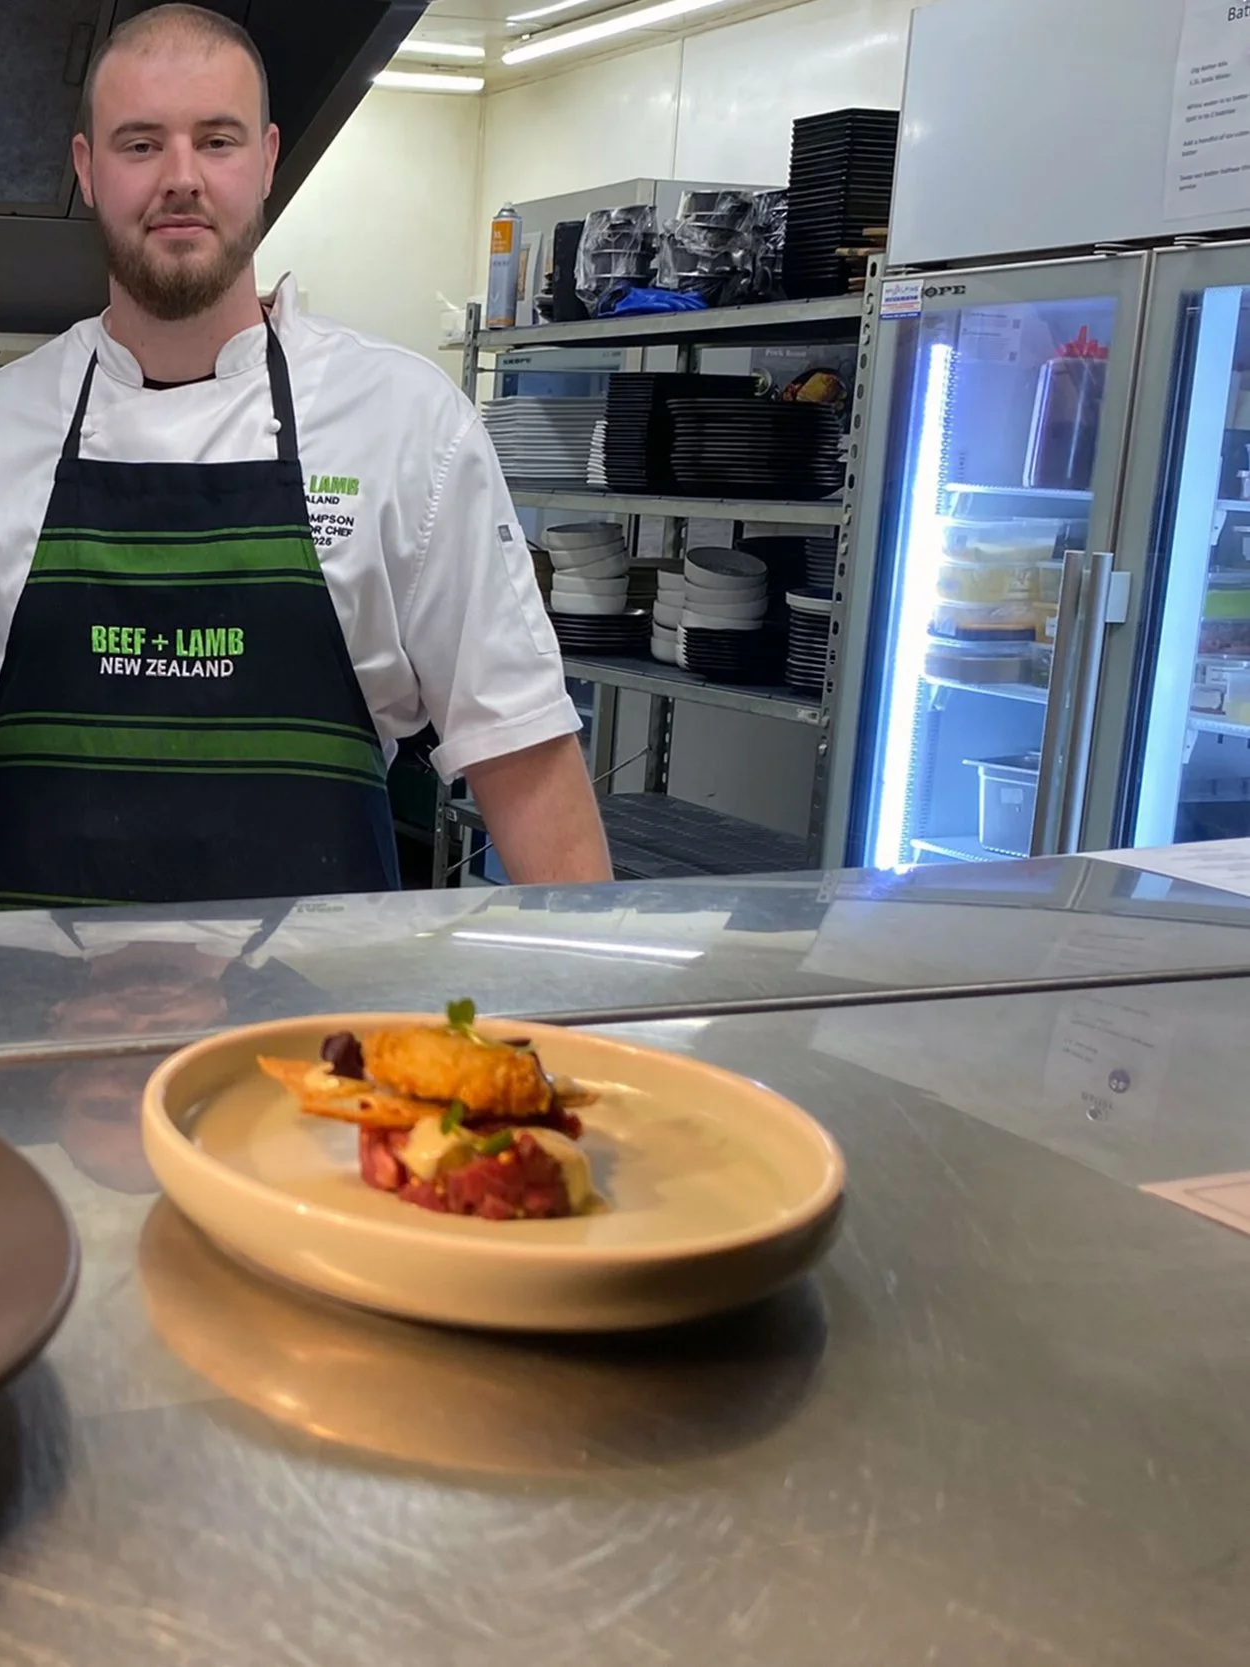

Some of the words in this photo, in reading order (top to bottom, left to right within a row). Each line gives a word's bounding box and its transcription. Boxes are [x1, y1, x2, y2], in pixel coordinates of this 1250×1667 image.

[923, 285, 966, 298] OPE
[309, 475, 359, 496] LAMB
[325, 525, 353, 537] CHEF
[91, 625, 146, 656] BEEF
[151, 634, 169, 651] +
[176, 628, 244, 657] LAMB
[100, 656, 142, 676] NEW
[145, 658, 234, 678] ZEALAND
